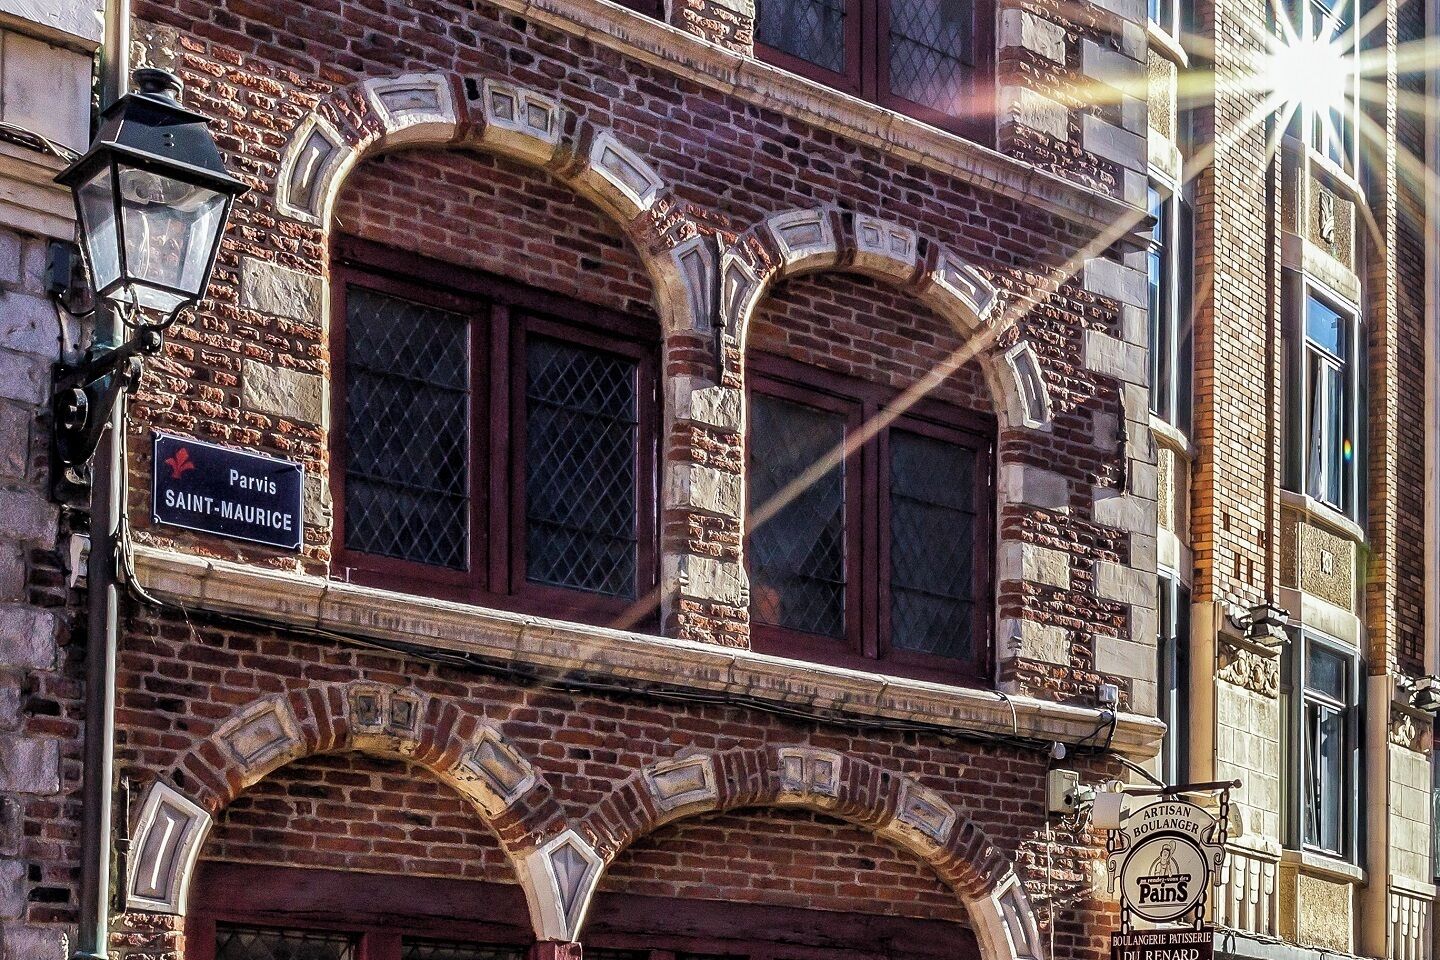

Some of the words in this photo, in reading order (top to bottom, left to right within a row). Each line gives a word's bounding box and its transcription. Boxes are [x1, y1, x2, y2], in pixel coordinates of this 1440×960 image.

[229, 468, 278, 496] Parvis
[164, 488, 293, 532] SAINT-MAURICE
[1143, 805, 1192, 821] ARTISAN
[1133, 818, 1200, 838] BOULANGER
[1112, 933, 1167, 947] BOULANGERIE
[1169, 931, 1212, 944] PATISSERIE
